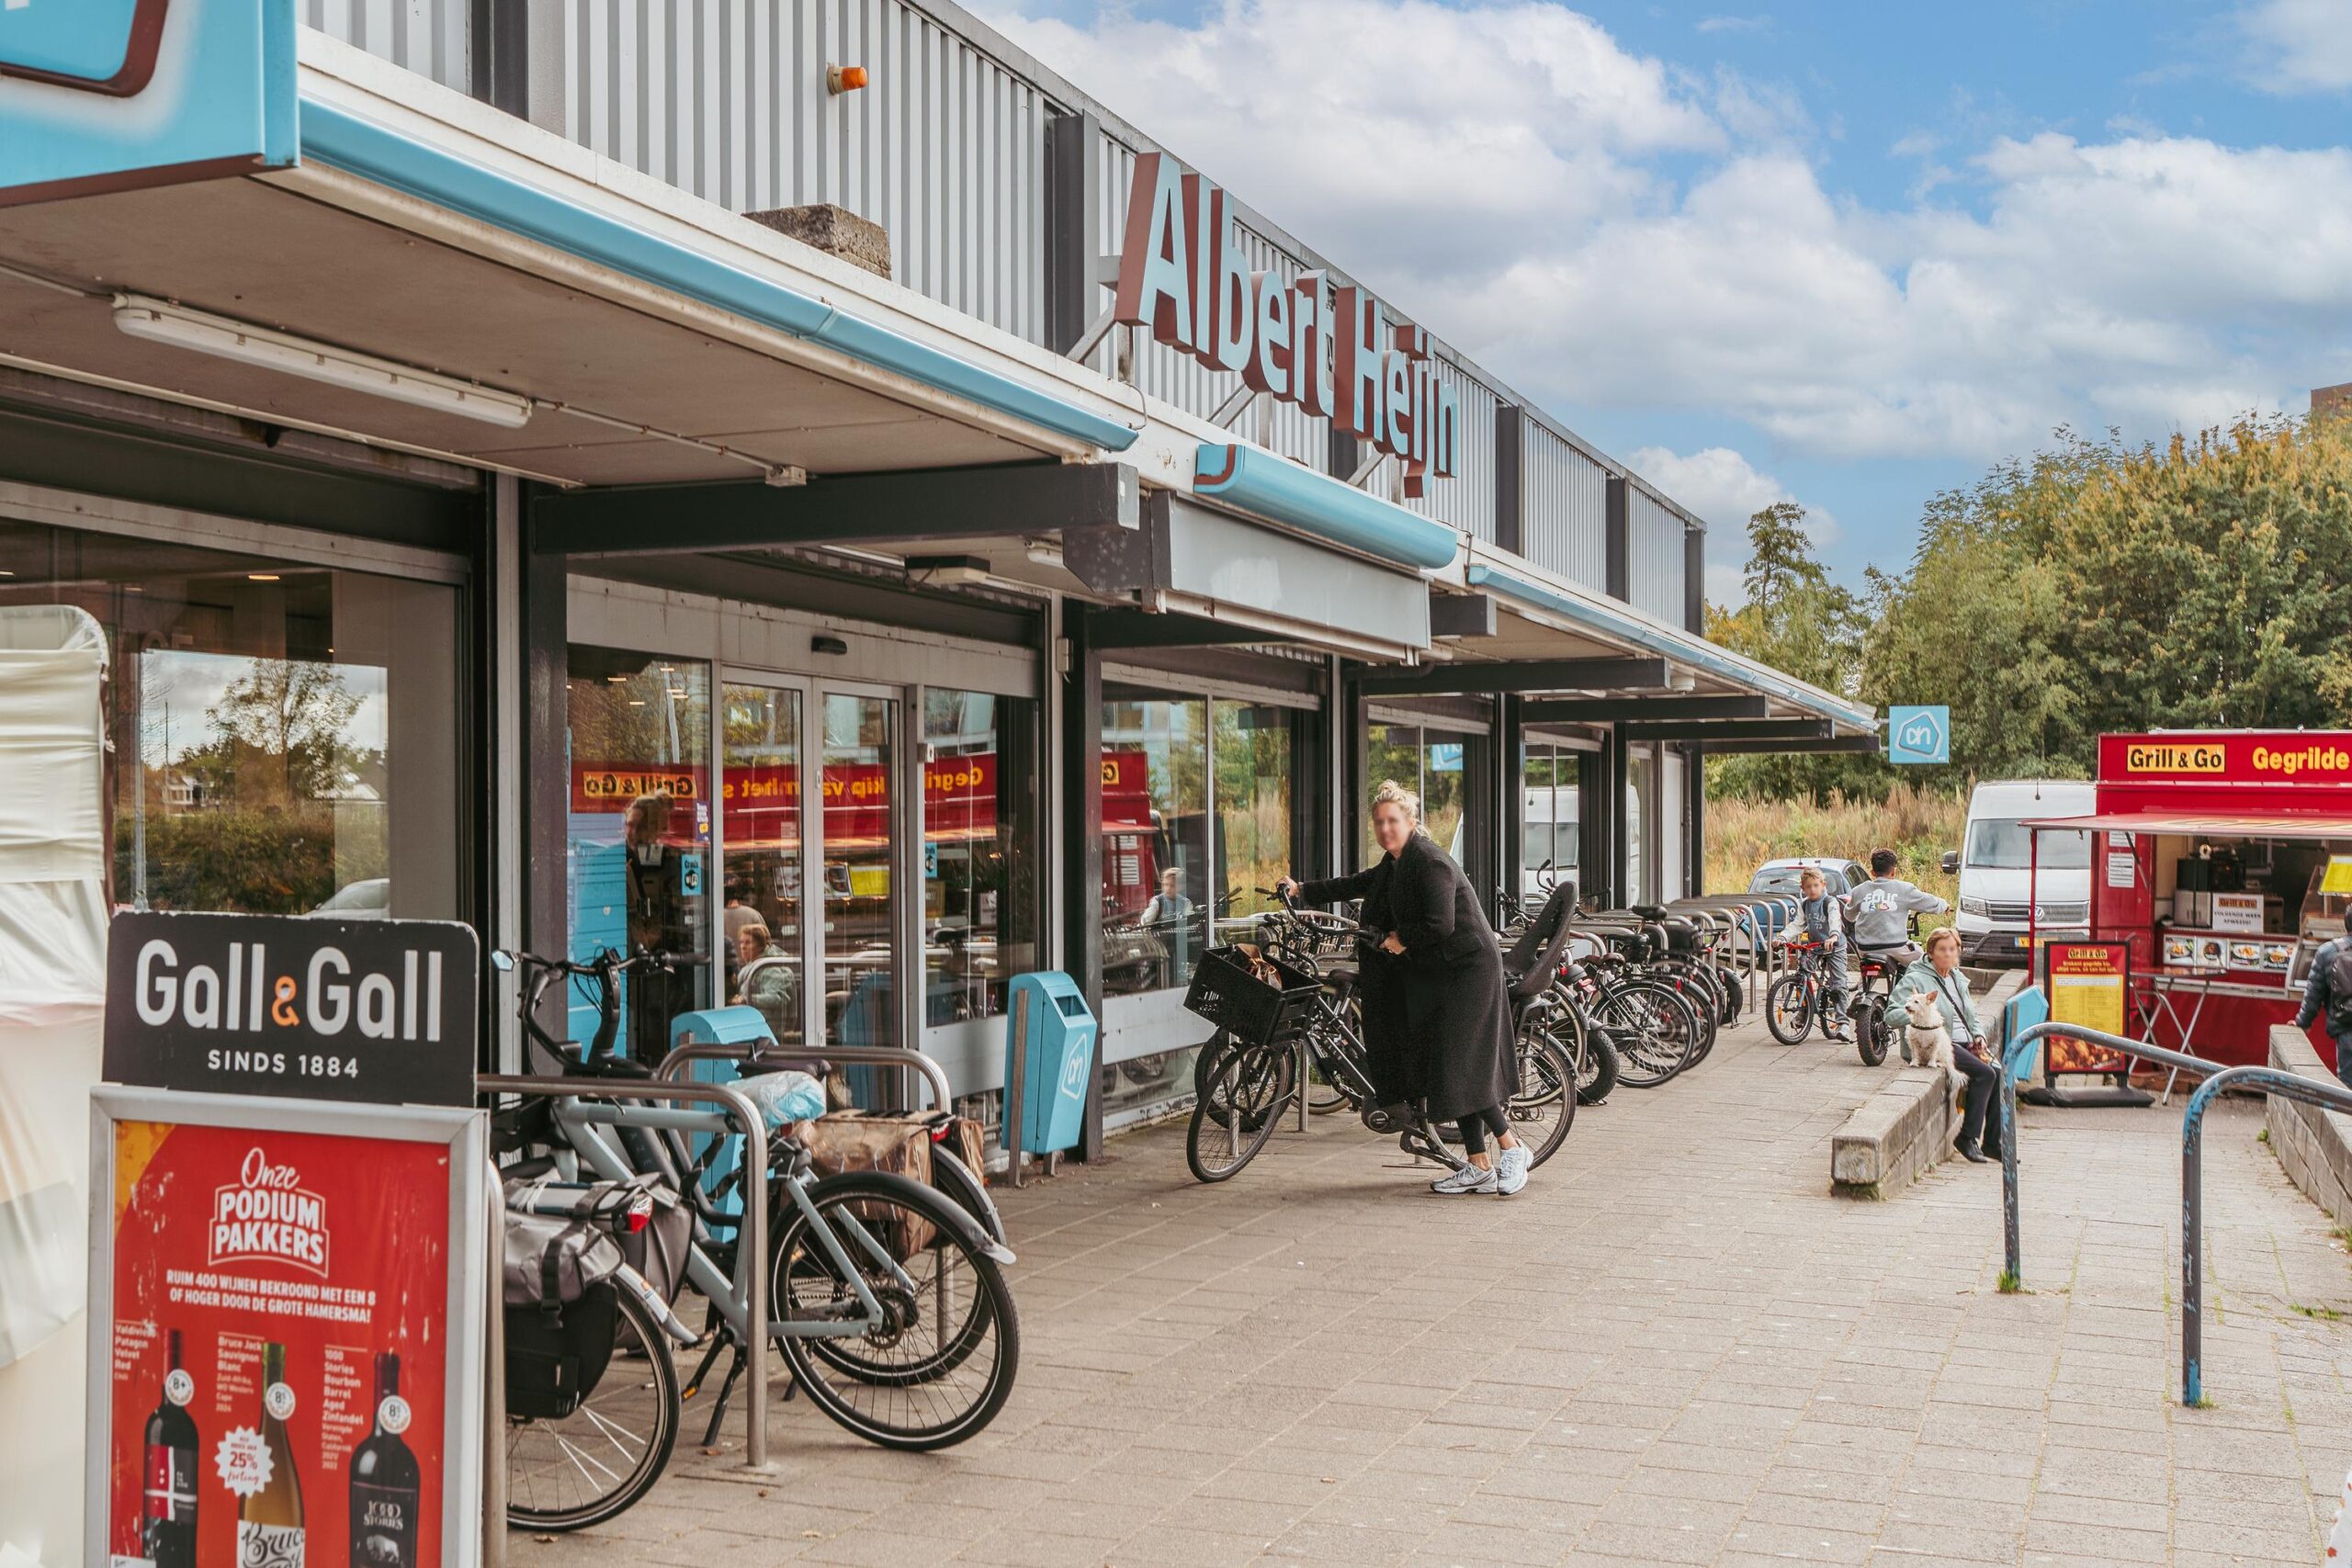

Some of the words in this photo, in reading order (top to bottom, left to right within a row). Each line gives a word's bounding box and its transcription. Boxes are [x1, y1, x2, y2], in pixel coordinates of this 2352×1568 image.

[1115, 152, 1335, 418] Albert
[1335, 287, 1458, 499] Heijn
[2130, 748, 2173, 769] Grill
[2177, 751, 2188, 768] &
[2194, 748, 2222, 768] Go
[2252, 747, 2350, 774] Gegrilde
[2069, 949, 2087, 958] Grill
[134, 938, 266, 1032] Gall
[271, 975, 300, 1027] &
[306, 945, 442, 1043] Gall
[207, 1048, 286, 1074] SINDS
[298, 1054, 359, 1079] 1884
[241, 1146, 300, 1189] Onze
[220, 1190, 320, 1231] PODIUM
[215, 1222, 323, 1265] PAKKERS
[166, 1269, 194, 1285] RUIM
[196, 1272, 218, 1288] 400
[220, 1275, 257, 1293] WIJNEN
[260, 1280, 319, 1299] BEKROOND
[321, 1286, 343, 1303] MET
[345, 1289, 368, 1304] EEN
[368, 1291, 376, 1306] 8
[170, 1288, 184, 1302] OF
[185, 1290, 220, 1306] HOGER
[222, 1293, 250, 1309] DOOR
[252, 1297, 266, 1312] DE
[268, 1298, 303, 1316] GROTE
[305, 1303, 371, 1323] HAMERSMA!
[218, 1336, 243, 1348] Bruce
[217, 1359, 241, 1372] Blanc
[323, 1373, 361, 1388] Bourbon
[322, 1410, 364, 1426] Zinfandel
[230, 1451, 258, 1470] 25%
